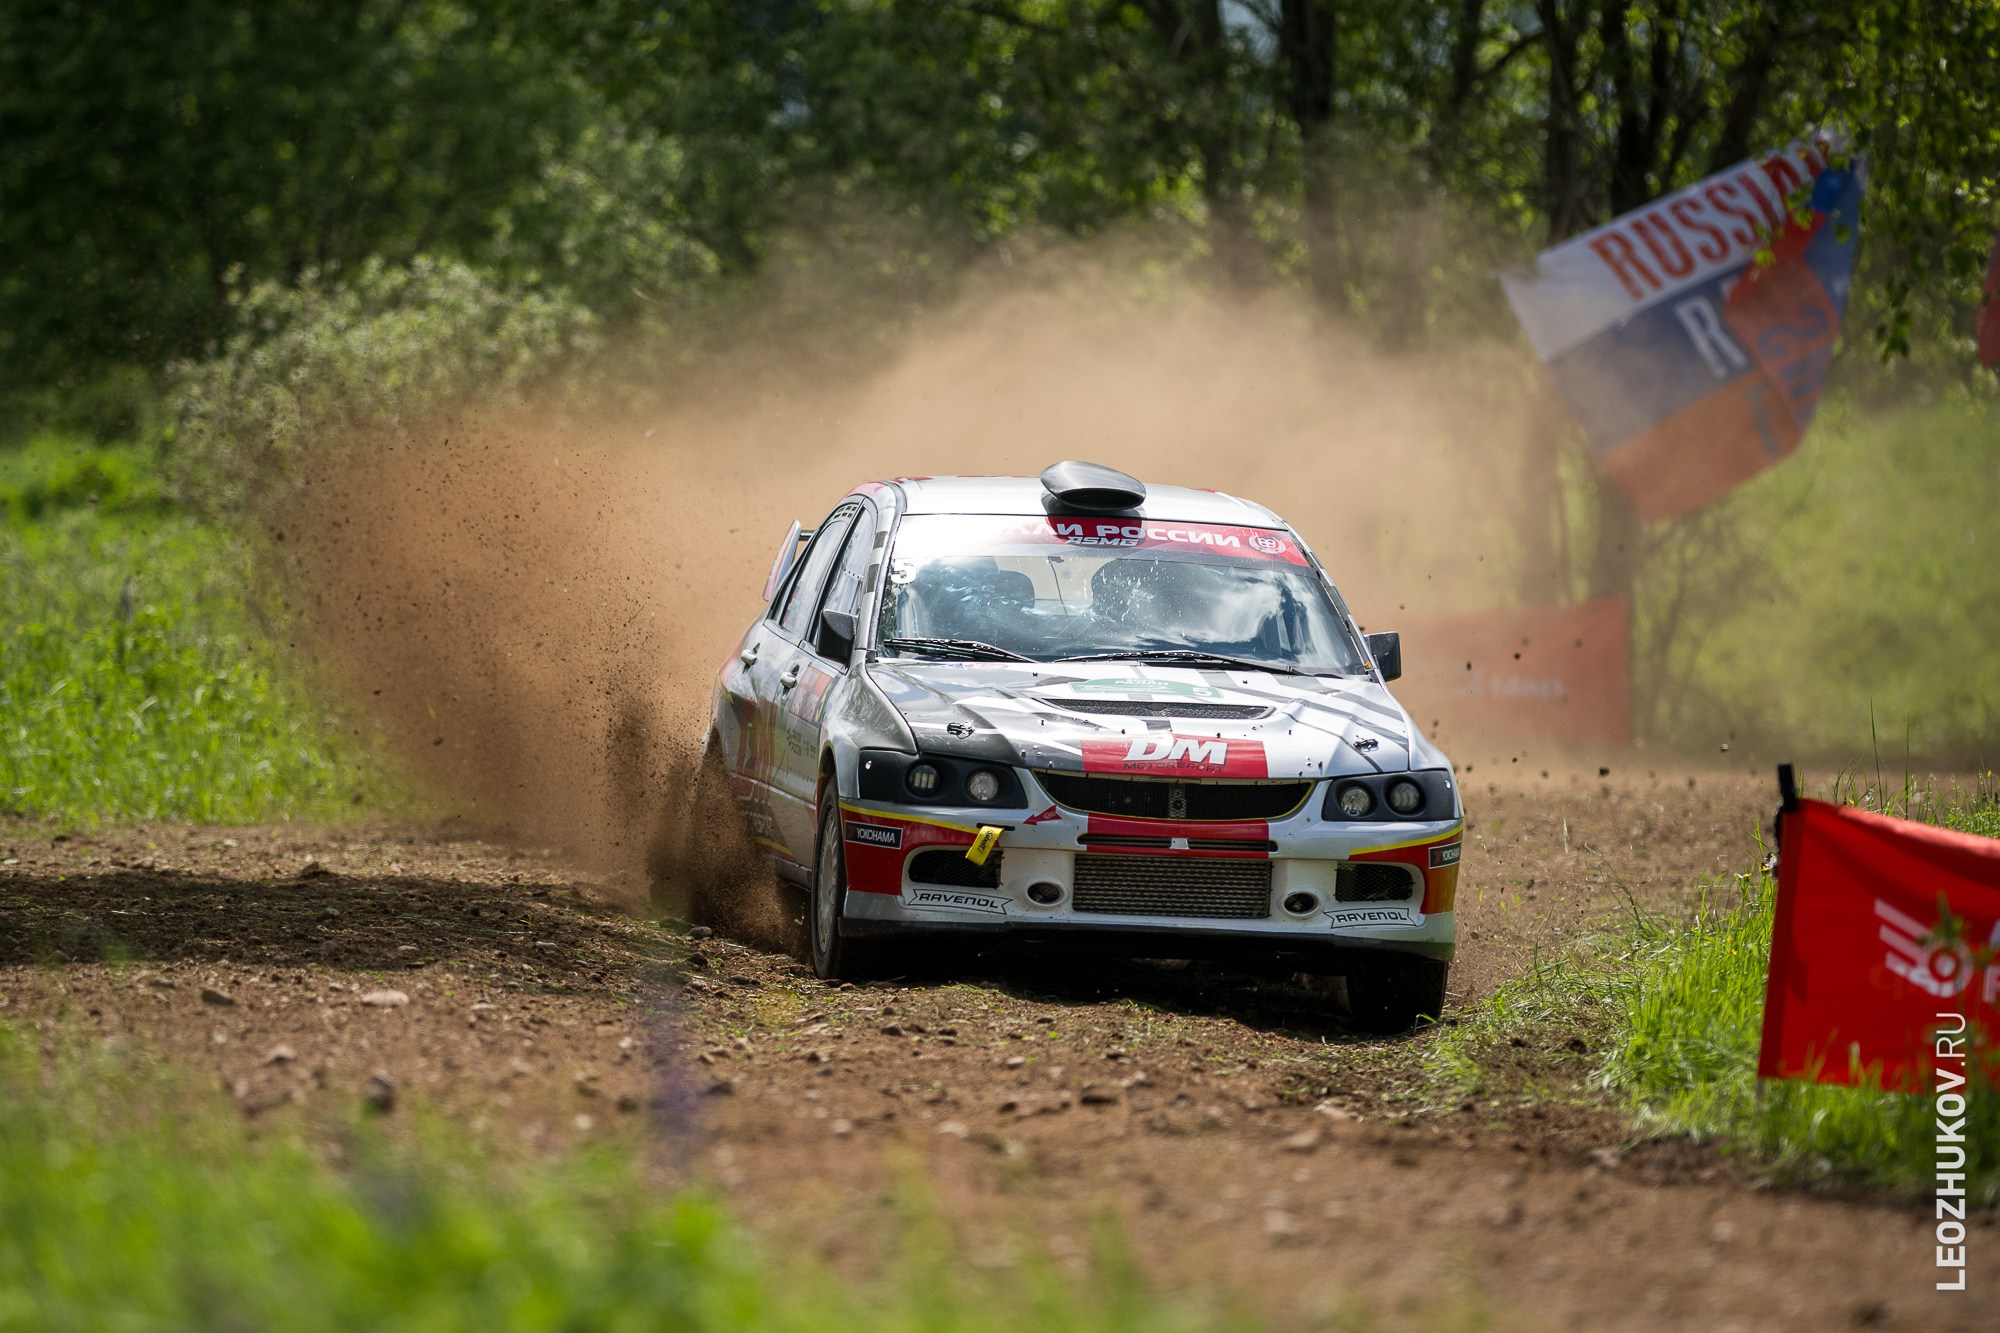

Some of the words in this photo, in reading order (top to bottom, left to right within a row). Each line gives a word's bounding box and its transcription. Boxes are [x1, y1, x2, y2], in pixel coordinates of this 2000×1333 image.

[1096, 524, 1242, 548] РОССИИ
[1192, 686, 1213, 697] 5
[1123, 736, 1230, 766] DM
[1123, 761, 1223, 773] MOTORSPORT
[856, 827, 896, 844] YOKOHAMA
[919, 892, 999, 909] RAVENOL
[1335, 911, 1408, 923] RAVENOL
